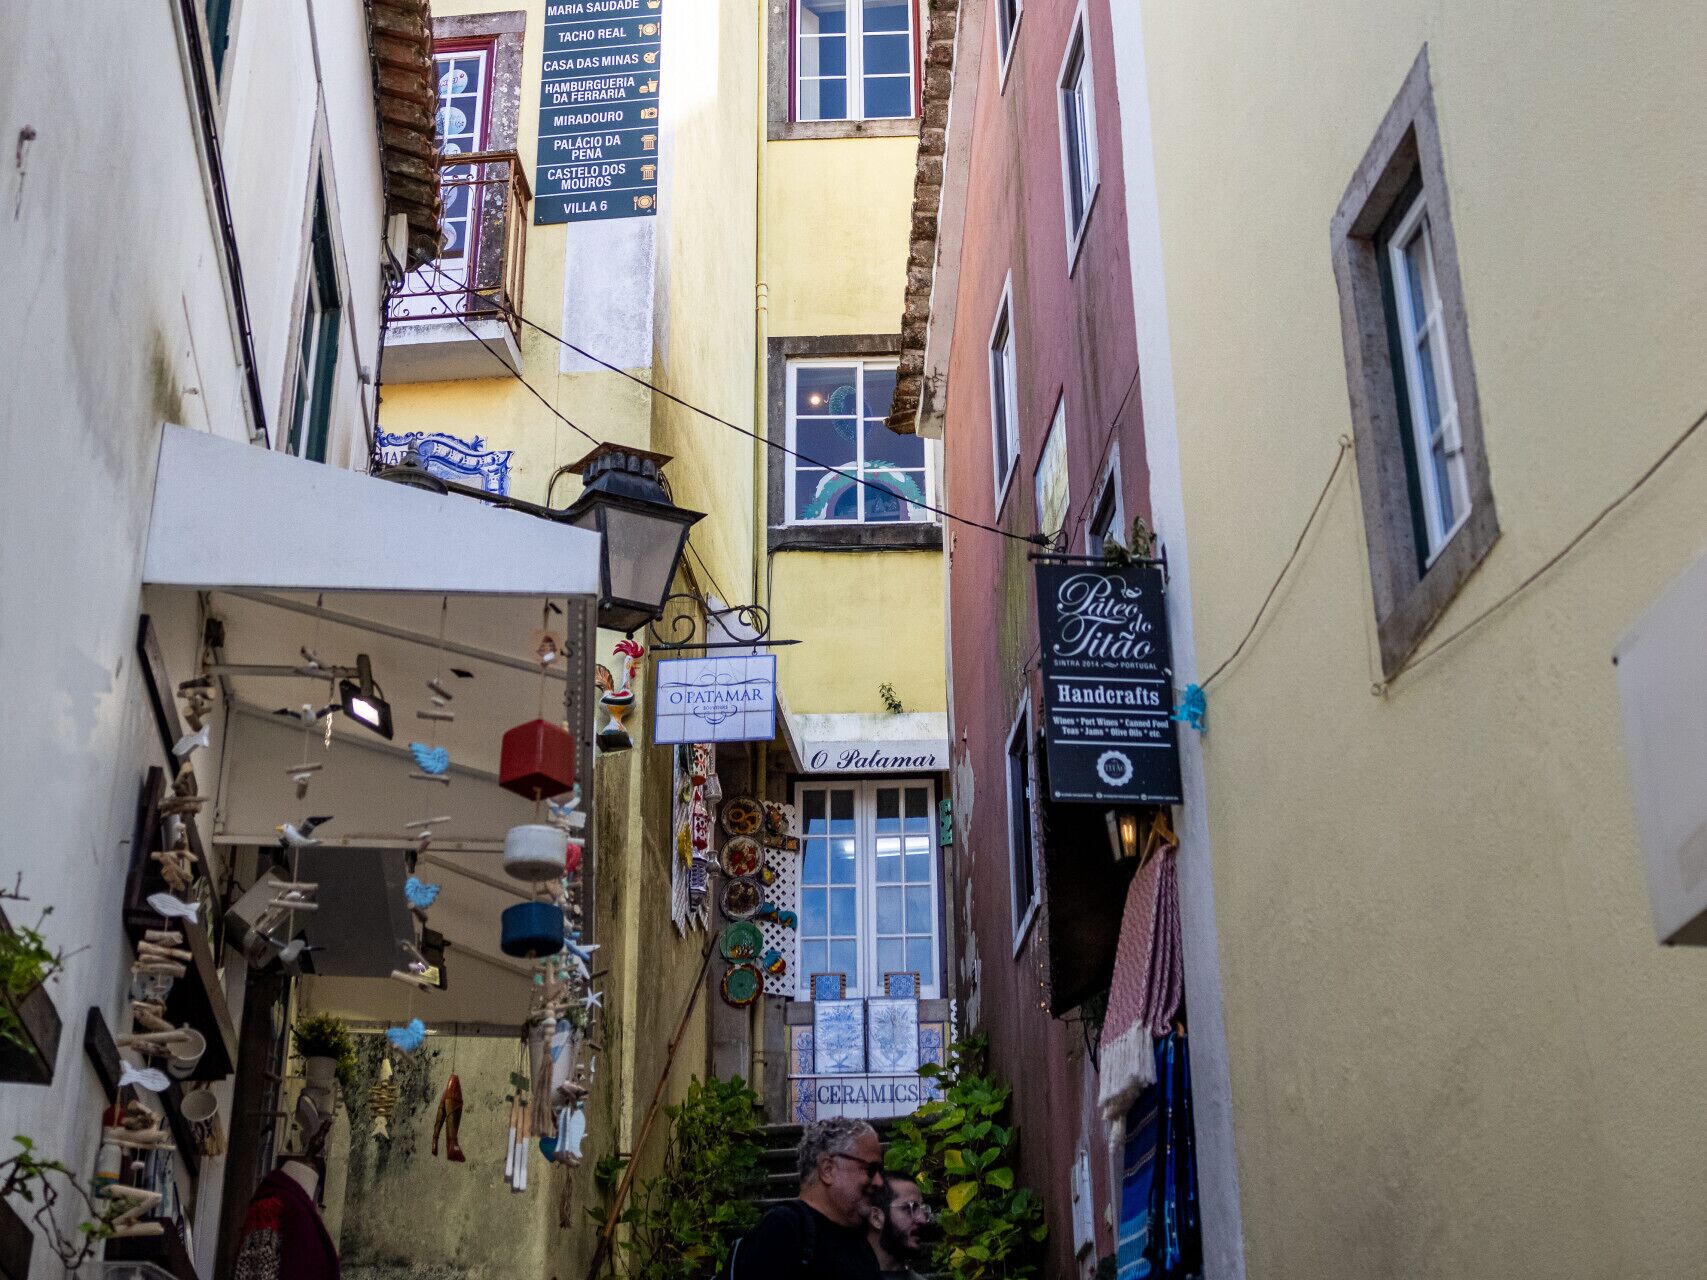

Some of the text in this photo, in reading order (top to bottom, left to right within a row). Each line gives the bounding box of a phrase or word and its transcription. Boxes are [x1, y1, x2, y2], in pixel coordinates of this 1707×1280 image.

[547, 0, 640, 16] MARIA SAUDADE
[558, 27, 626, 42] TACHO REAL
[543, 53, 639, 71] CASA DAS MINAS
[545, 77, 635, 94] HAMBURGUERIA
[553, 89, 626, 104] DA FERRARIA
[554, 111, 624, 127] MIRADOURO
[554, 135, 621, 150] PALÁCIO DA
[571, 148, 602, 160] PENA
[547, 164, 626, 180] CASTELO DOS
[561, 176, 612, 190] MOUROS
[564, 200, 608, 214] VILLA 6
[1129, 614, 1153, 634] do
[1054, 614, 1155, 660] Titão
[1054, 659, 1080, 667] SINTRA
[1121, 662, 1157, 670] PORTUGAL
[669, 688, 764, 704] O PATAMAR
[1058, 685, 1160, 705] Handcrafts
[1053, 716, 1169, 728] Wines Port Wines Canned Food
[1062, 727, 1079, 735] Teas
[1085, 728, 1103, 736] Jams
[1149, 730, 1161, 738] etc.
[811, 749, 936, 769] O Patamar
[817, 1083, 919, 1105] CERAMICS
